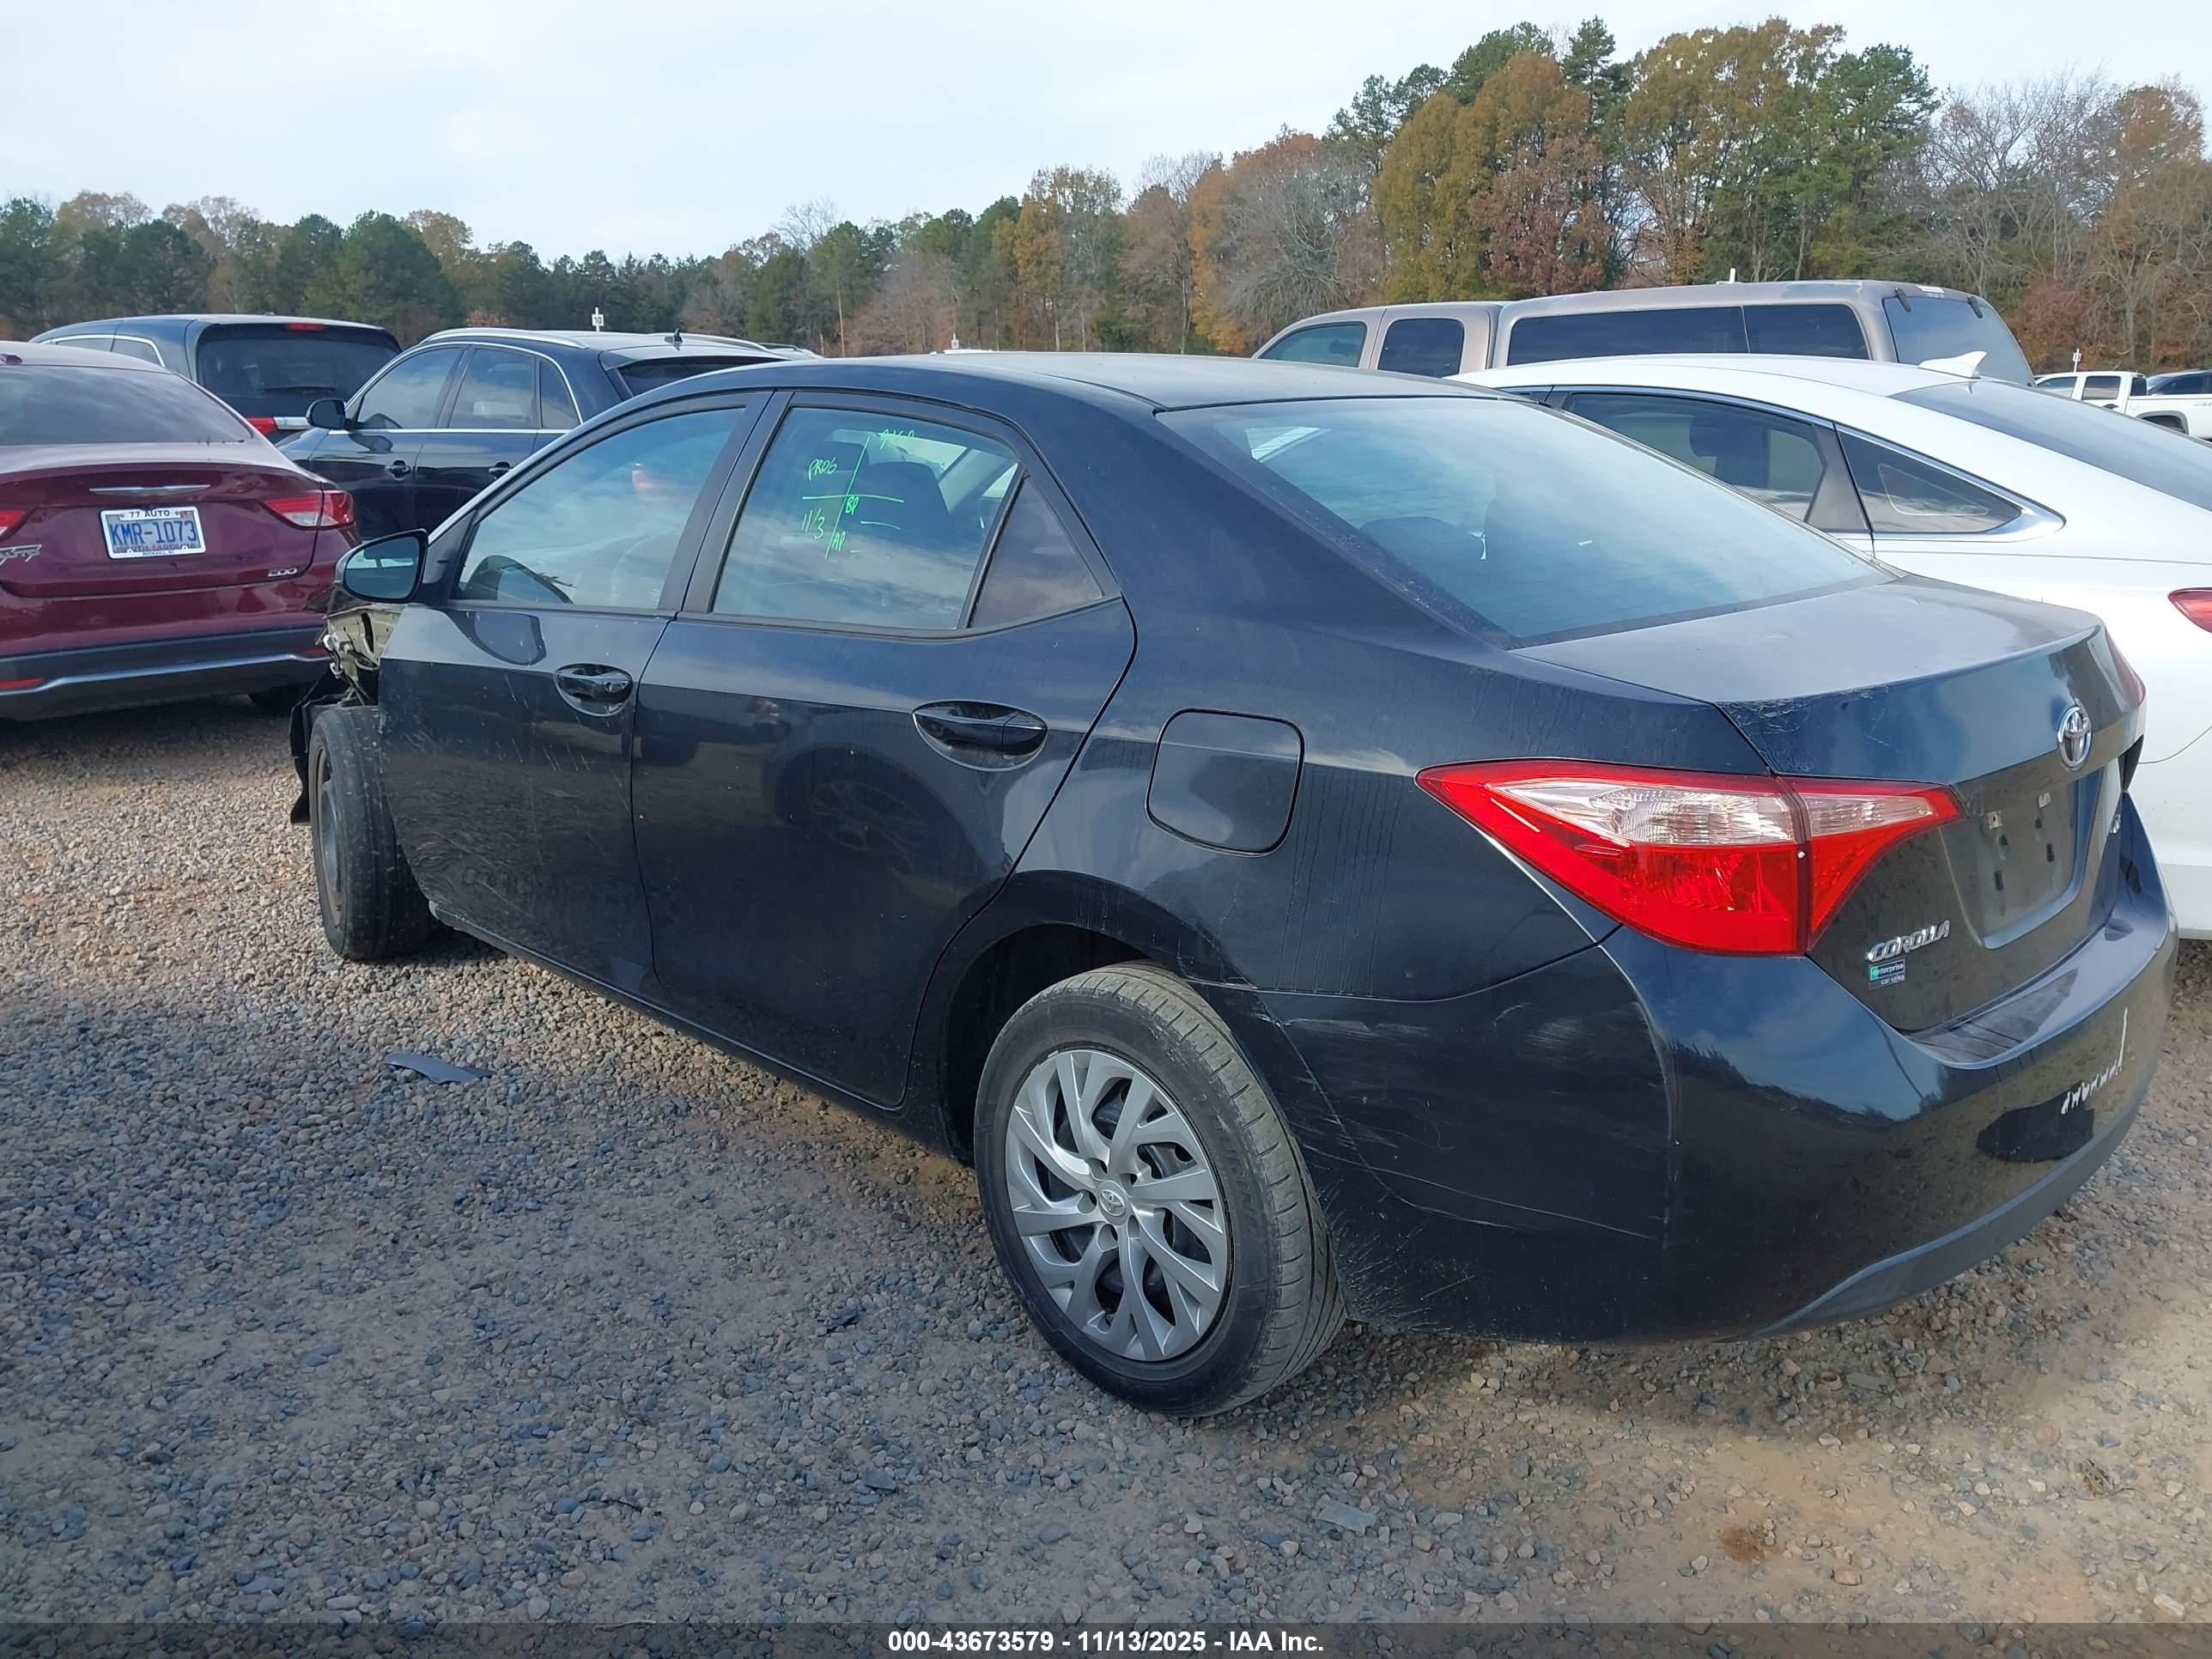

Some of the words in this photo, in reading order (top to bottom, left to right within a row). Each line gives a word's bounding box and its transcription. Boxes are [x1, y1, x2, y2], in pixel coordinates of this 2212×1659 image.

[109, 520, 198, 546] KMR-1073
[1867, 920, 1950, 963] COROLLA
[1872, 963, 1905, 976] enterprise
